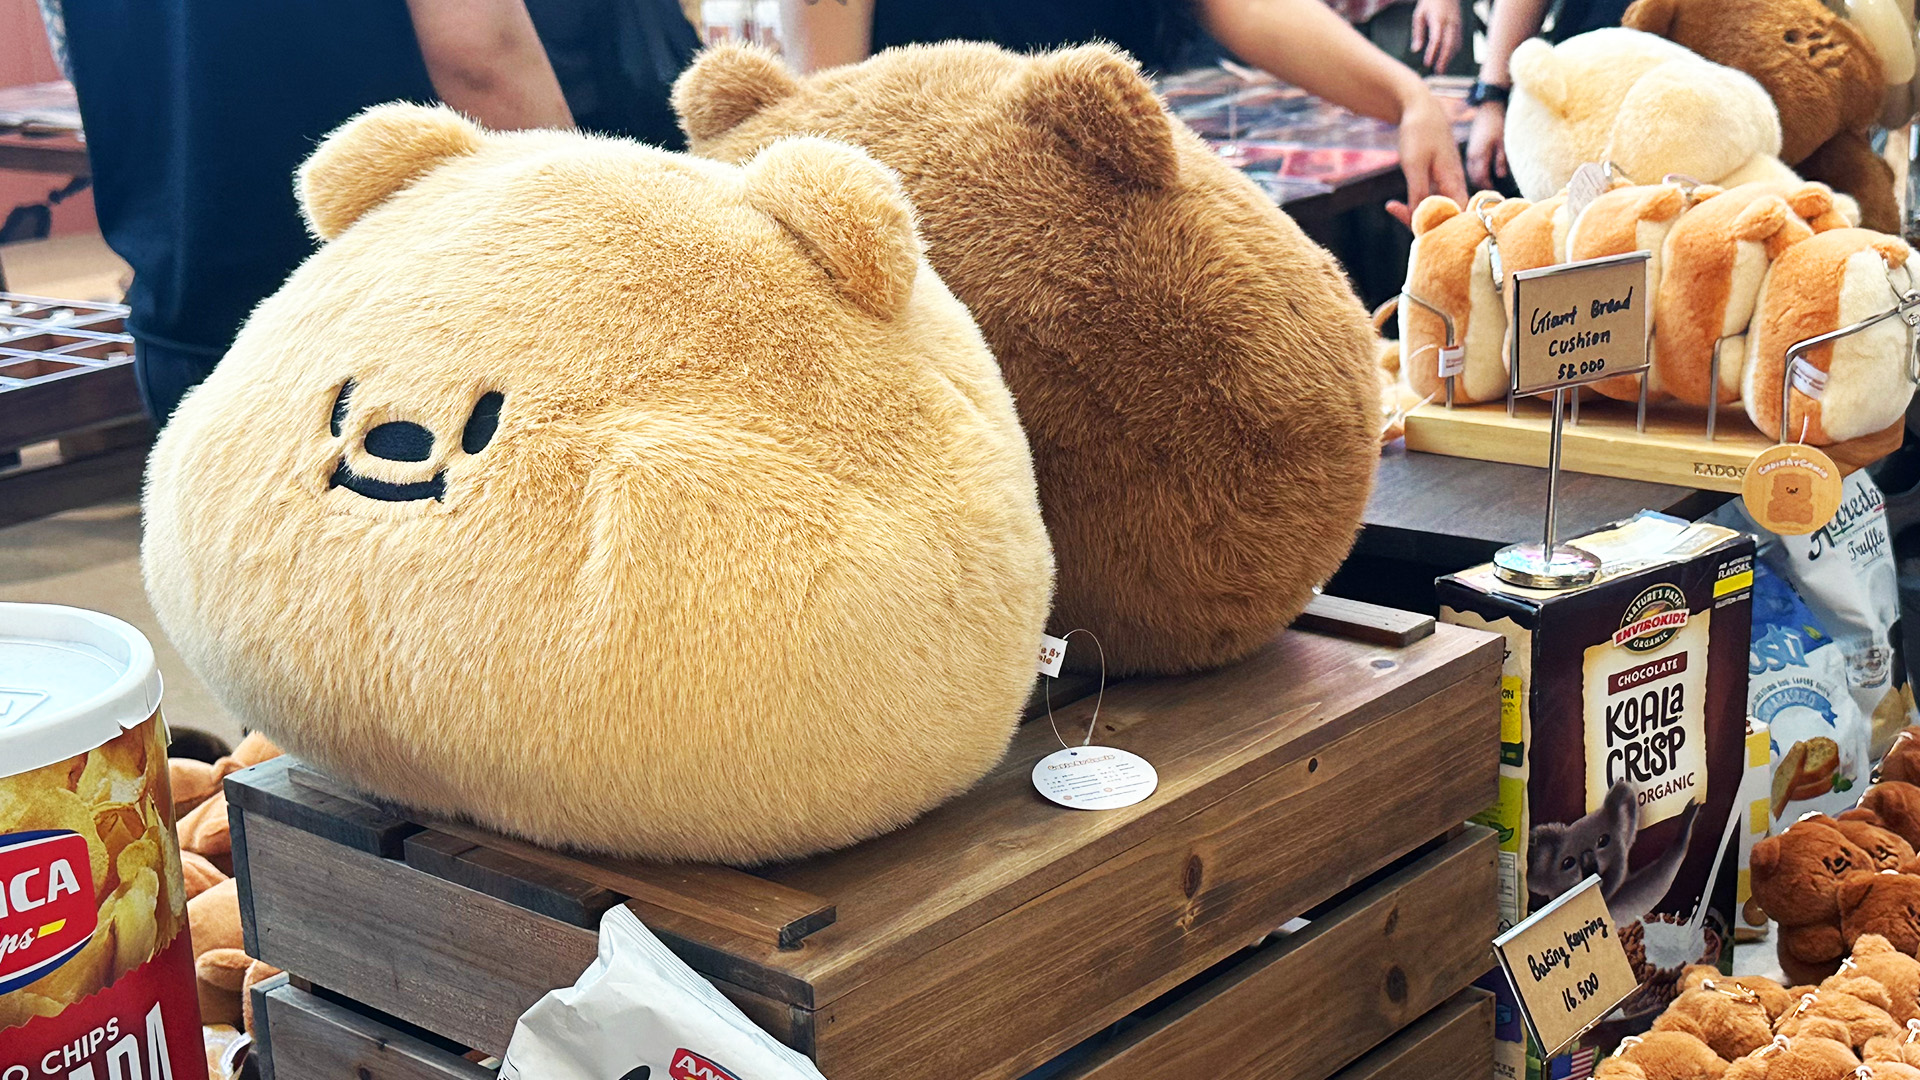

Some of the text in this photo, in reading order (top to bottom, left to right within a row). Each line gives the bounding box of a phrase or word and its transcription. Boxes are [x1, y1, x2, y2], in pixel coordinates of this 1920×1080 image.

[1617, 657, 1679, 687] CHOCOLATE
[1637, 772, 1695, 807] ORGANIC
[41, 1016, 120, 1075] CHIPS
